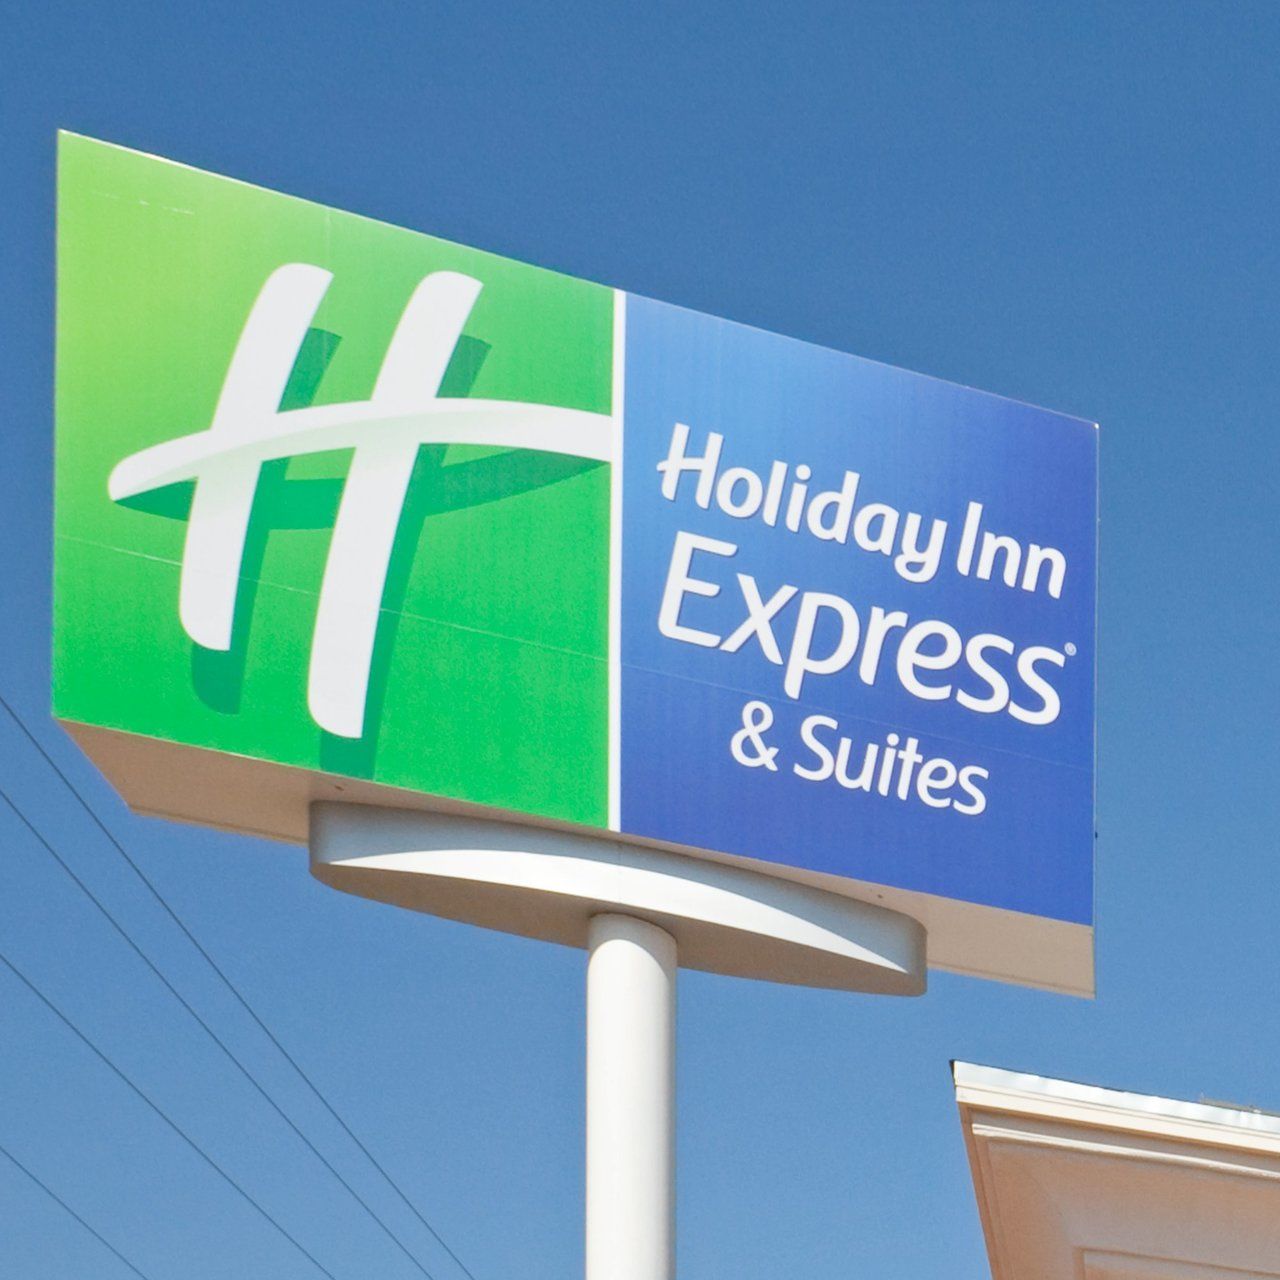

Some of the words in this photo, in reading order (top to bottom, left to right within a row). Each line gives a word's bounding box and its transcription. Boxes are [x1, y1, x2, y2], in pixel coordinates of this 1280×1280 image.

[656, 422, 948, 583] Holiday
[956, 501, 1066, 599] Inn
[658, 530, 1066, 725] Express
[730, 700, 779, 772] &
[793, 714, 989, 815] Suites
